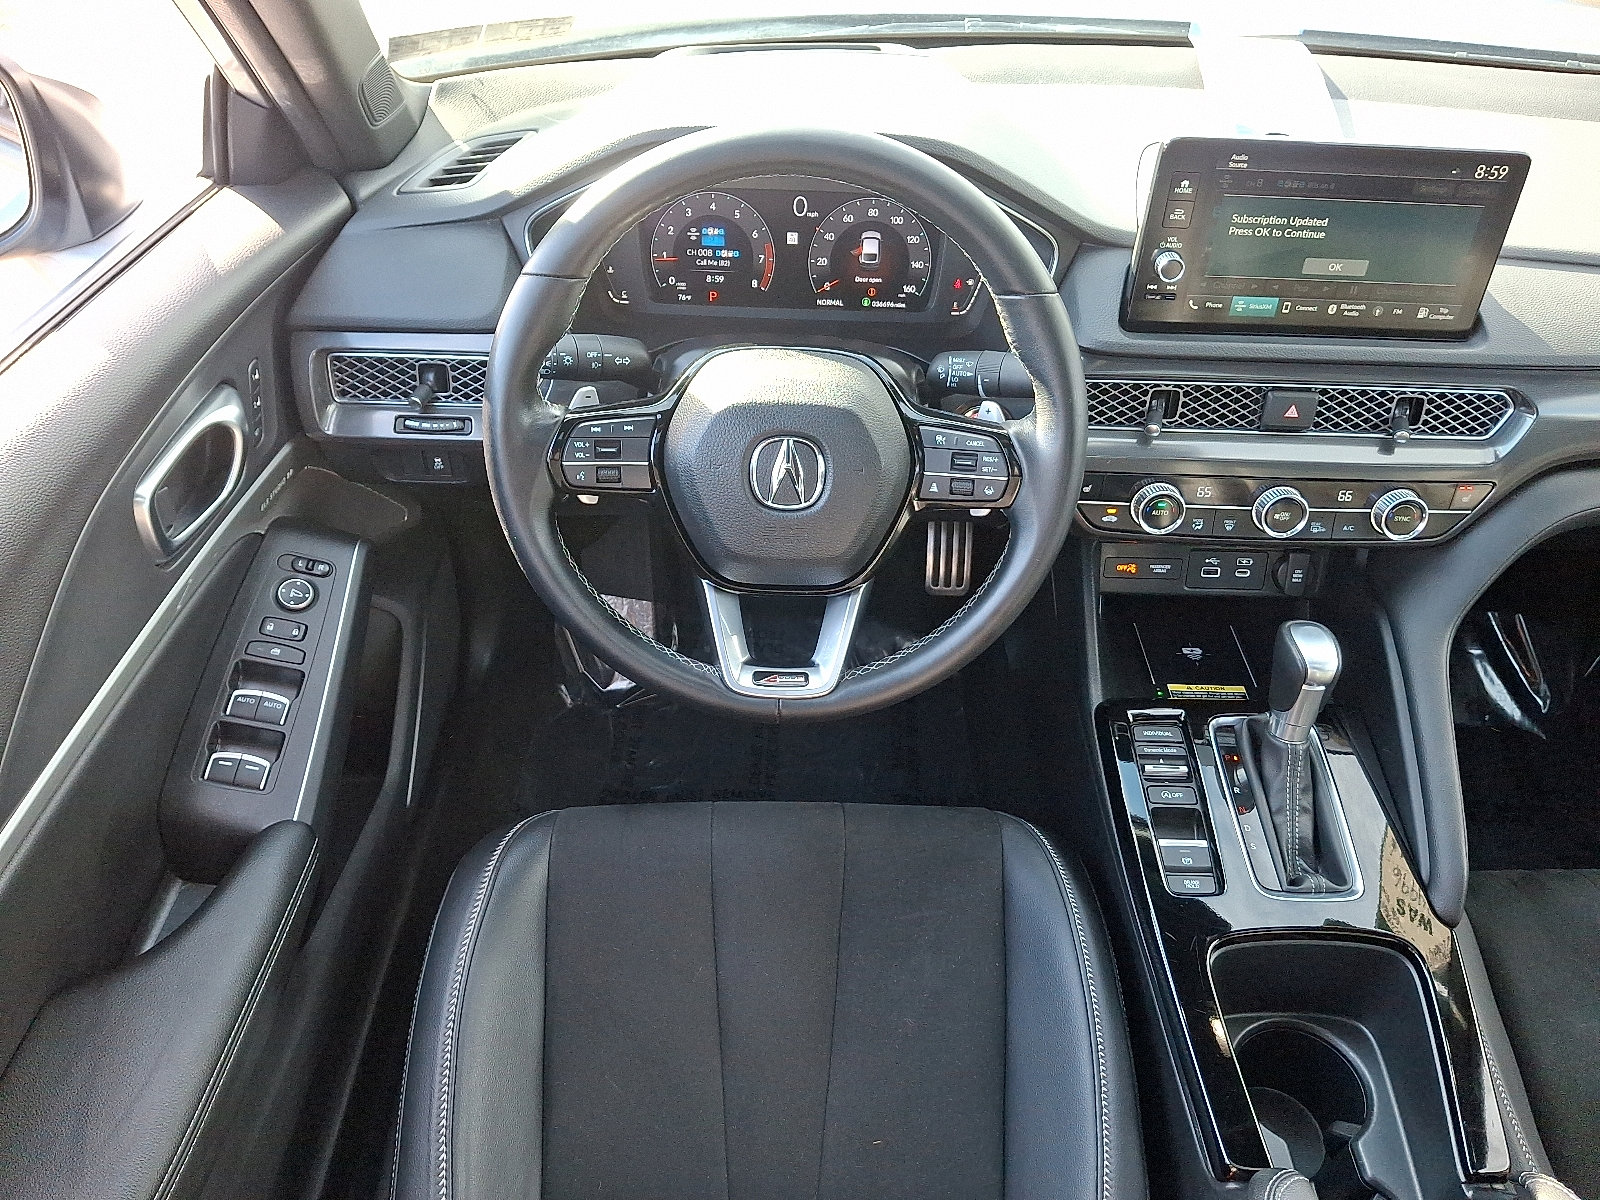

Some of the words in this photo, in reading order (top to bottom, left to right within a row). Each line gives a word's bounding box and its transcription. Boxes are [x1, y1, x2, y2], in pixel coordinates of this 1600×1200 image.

[1474, 164, 1509, 180] 8:59
[709, 202, 717, 211] 4
[793, 195, 808, 217] 0
[685, 208, 692, 217] 3
[734, 209, 740, 219] 5
[867, 208, 878, 217] 80
[843, 214, 854, 223] 60
[890, 216, 904, 225] 100
[1231, 214, 1288, 226] Subscription
[1289, 216, 1329, 227] Updated
[667, 226, 674, 235] 2
[752, 229, 759, 239] 6
[1228, 227, 1253, 237] Press
[1254, 227, 1271, 237] OK
[1272, 228, 1282, 237] to
[1284, 228, 1326, 239] Continue
[824, 232, 835, 241] 40
[906, 236, 920, 244] 120
[686, 249, 697, 257] CH
[697, 249, 713, 258] 008
[758, 254, 765, 264] 7
[816, 257, 828, 266] 20
[911, 261, 924, 269] 140
[1328, 263, 1344, 272] OK
[668, 276, 676, 285] 0
[705, 275, 725, 284] 8:59
[751, 279, 758, 288] 8
[903, 285, 916, 293] 160
[709, 291, 718, 302] P
[1196, 486, 1212, 498] 65
[1337, 490, 1354, 502] 66
[236, 696, 256, 704] AUTO
[263, 701, 282, 709] AUTO
